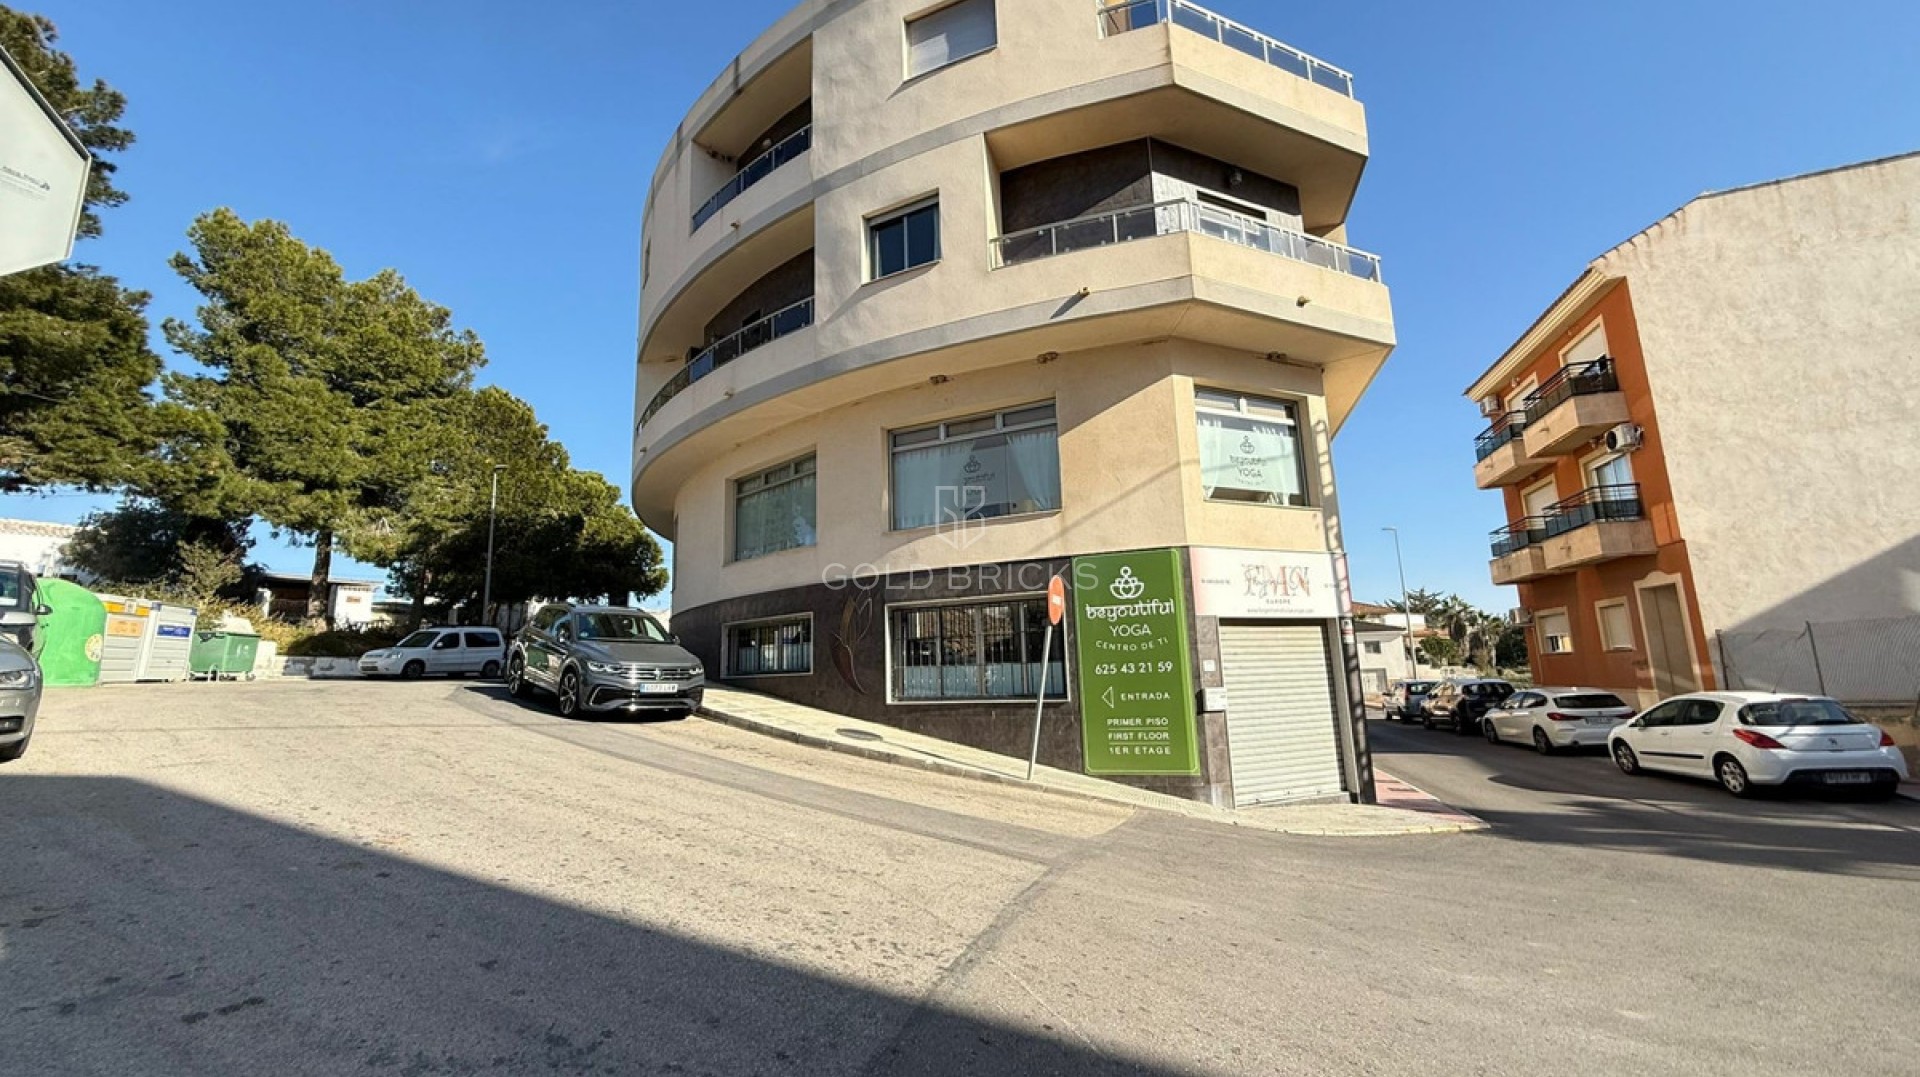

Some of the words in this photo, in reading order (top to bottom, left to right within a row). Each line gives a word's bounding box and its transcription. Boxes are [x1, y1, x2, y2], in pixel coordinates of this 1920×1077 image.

[1085, 598, 1175, 622] beyoutiful
[1109, 623, 1152, 637] YOGA
[1095, 640, 1137, 651] CENTRO
[1140, 641, 1154, 650] DE
[1095, 663, 1117, 675] 625
[1120, 662, 1136, 674] 43
[1138, 662, 1153, 673] 21
[1157, 661, 1174, 673] 59
[1120, 691, 1171, 701] ENTRADA
[1106, 717, 1142, 726] PRIMER
[1145, 717, 1169, 726] PISO
[1108, 732, 1134, 740] FIRST
[1137, 732, 1170, 740] FLOOR
[1109, 746, 1129, 755] 1ER
[1134, 746, 1171, 755] ETAGE
